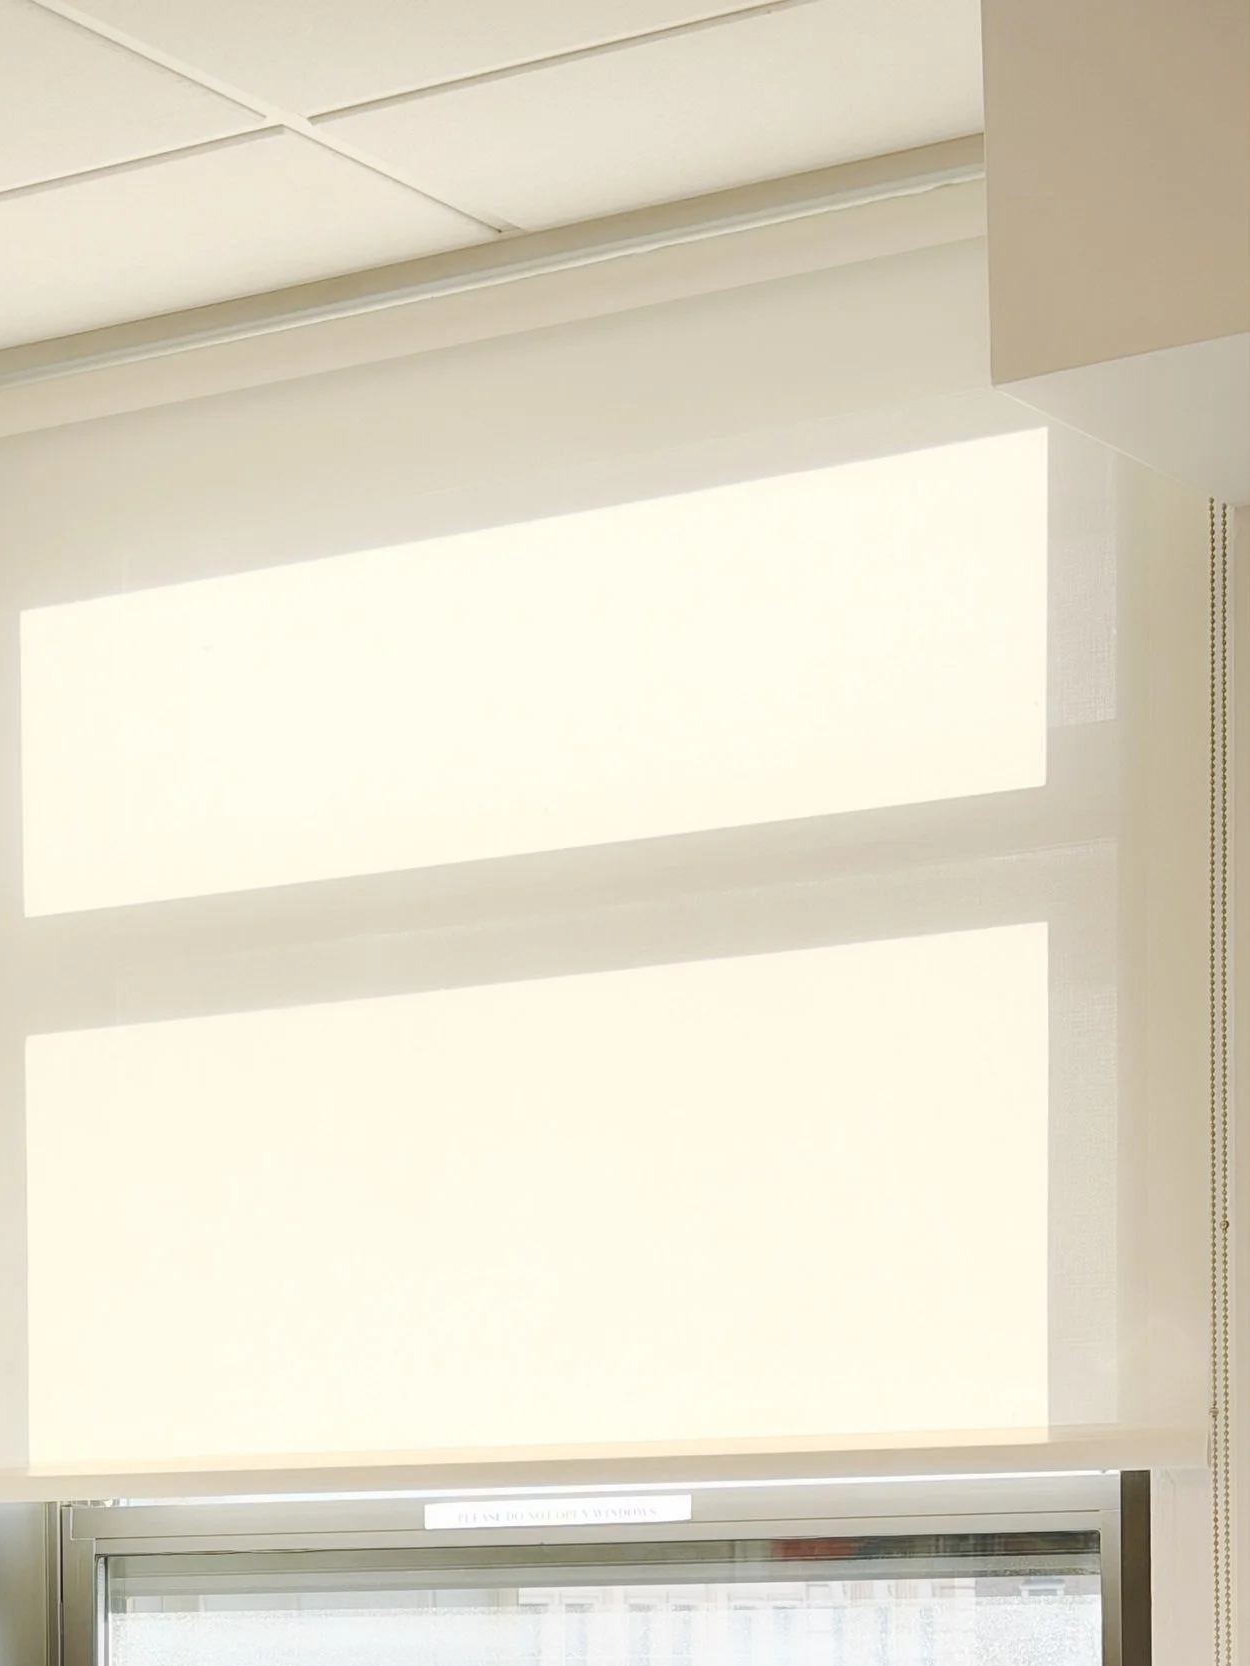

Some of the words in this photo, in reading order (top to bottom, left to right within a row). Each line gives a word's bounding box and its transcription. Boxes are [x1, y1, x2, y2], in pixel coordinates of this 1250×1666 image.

[457, 1511, 500, 1523] PLEASE
[506, 1511, 524, 1522] DO
[528, 1510, 552, 1521] NOT
[555, 1509, 588, 1520] OPEN
[591, 1507, 657, 1519] WINDOWS
